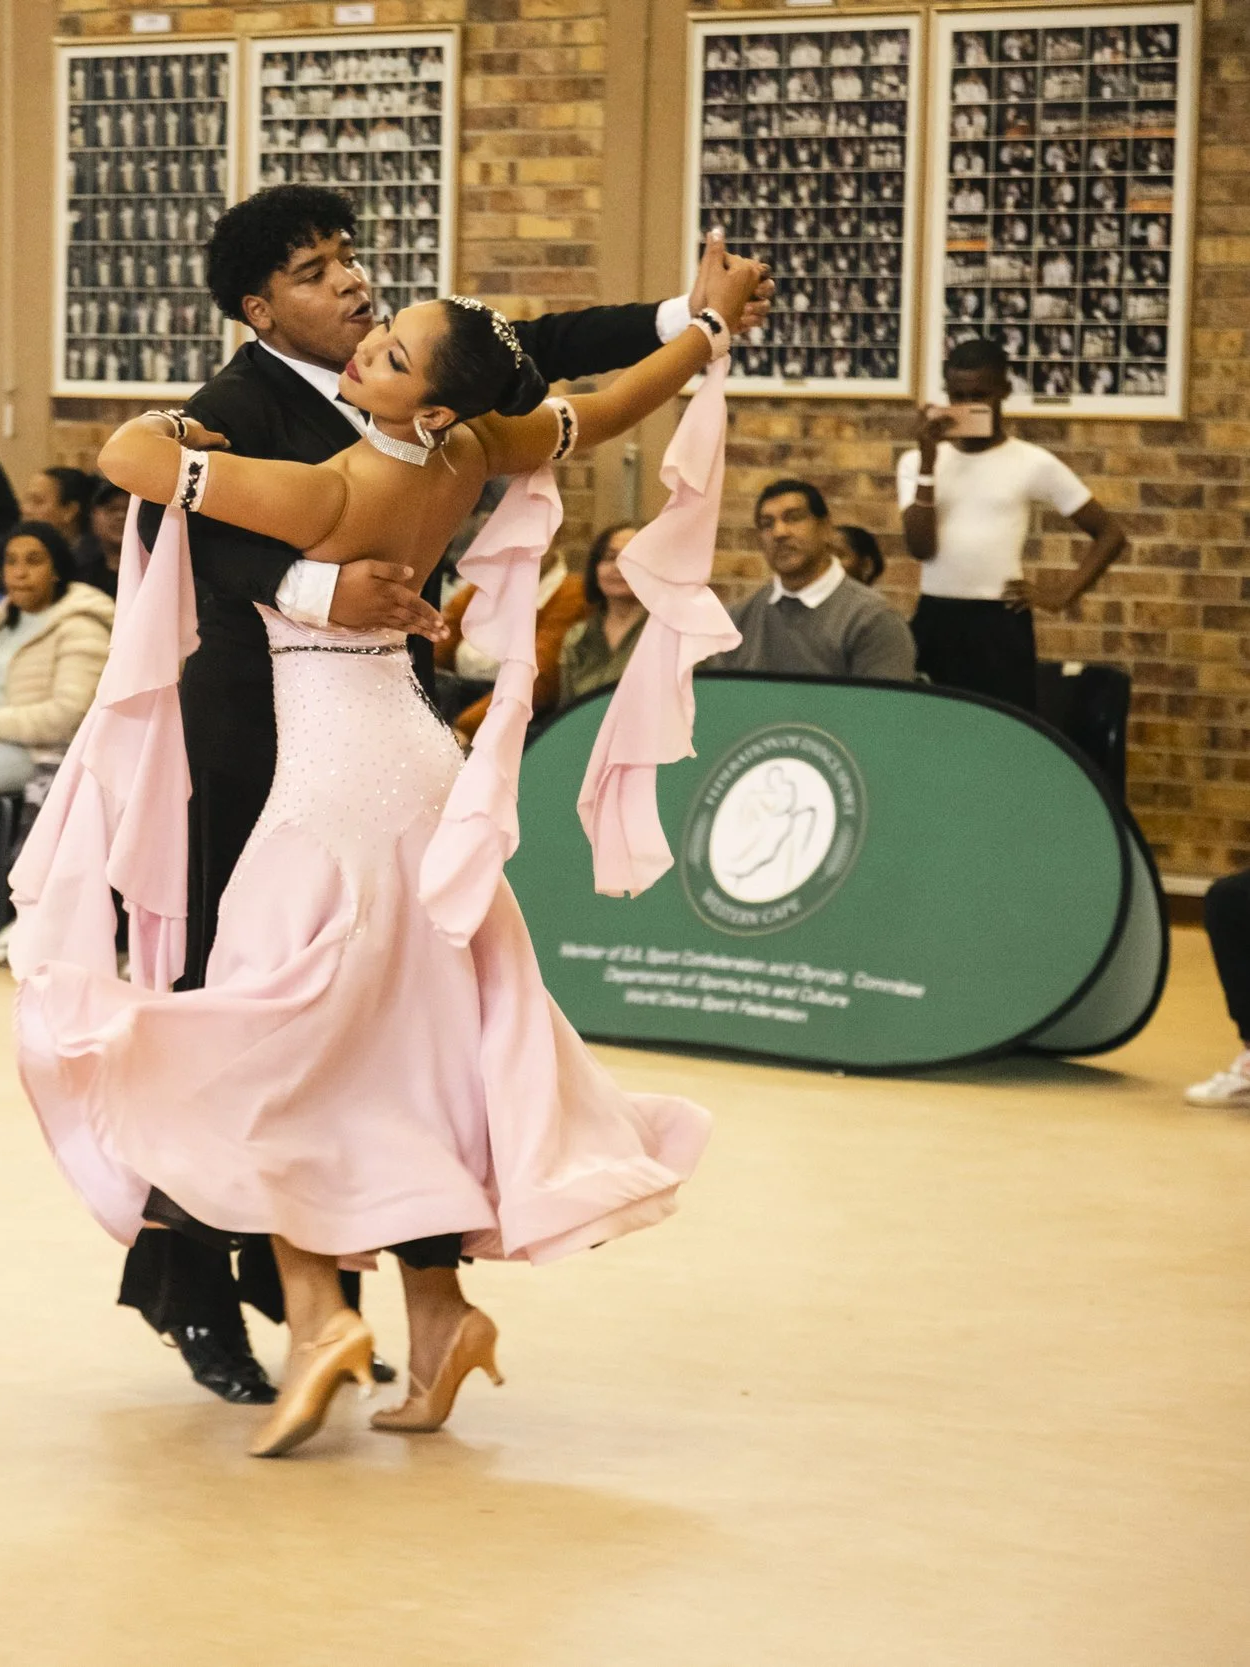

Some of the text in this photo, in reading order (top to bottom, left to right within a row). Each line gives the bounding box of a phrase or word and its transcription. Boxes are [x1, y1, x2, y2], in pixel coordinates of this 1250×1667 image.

[760, 898, 800, 924] CAPE
[767, 962, 794, 978] and
[793, 962, 847, 987] Olympic
[771, 985, 797, 1002] and
[798, 985, 849, 1009] Culture
